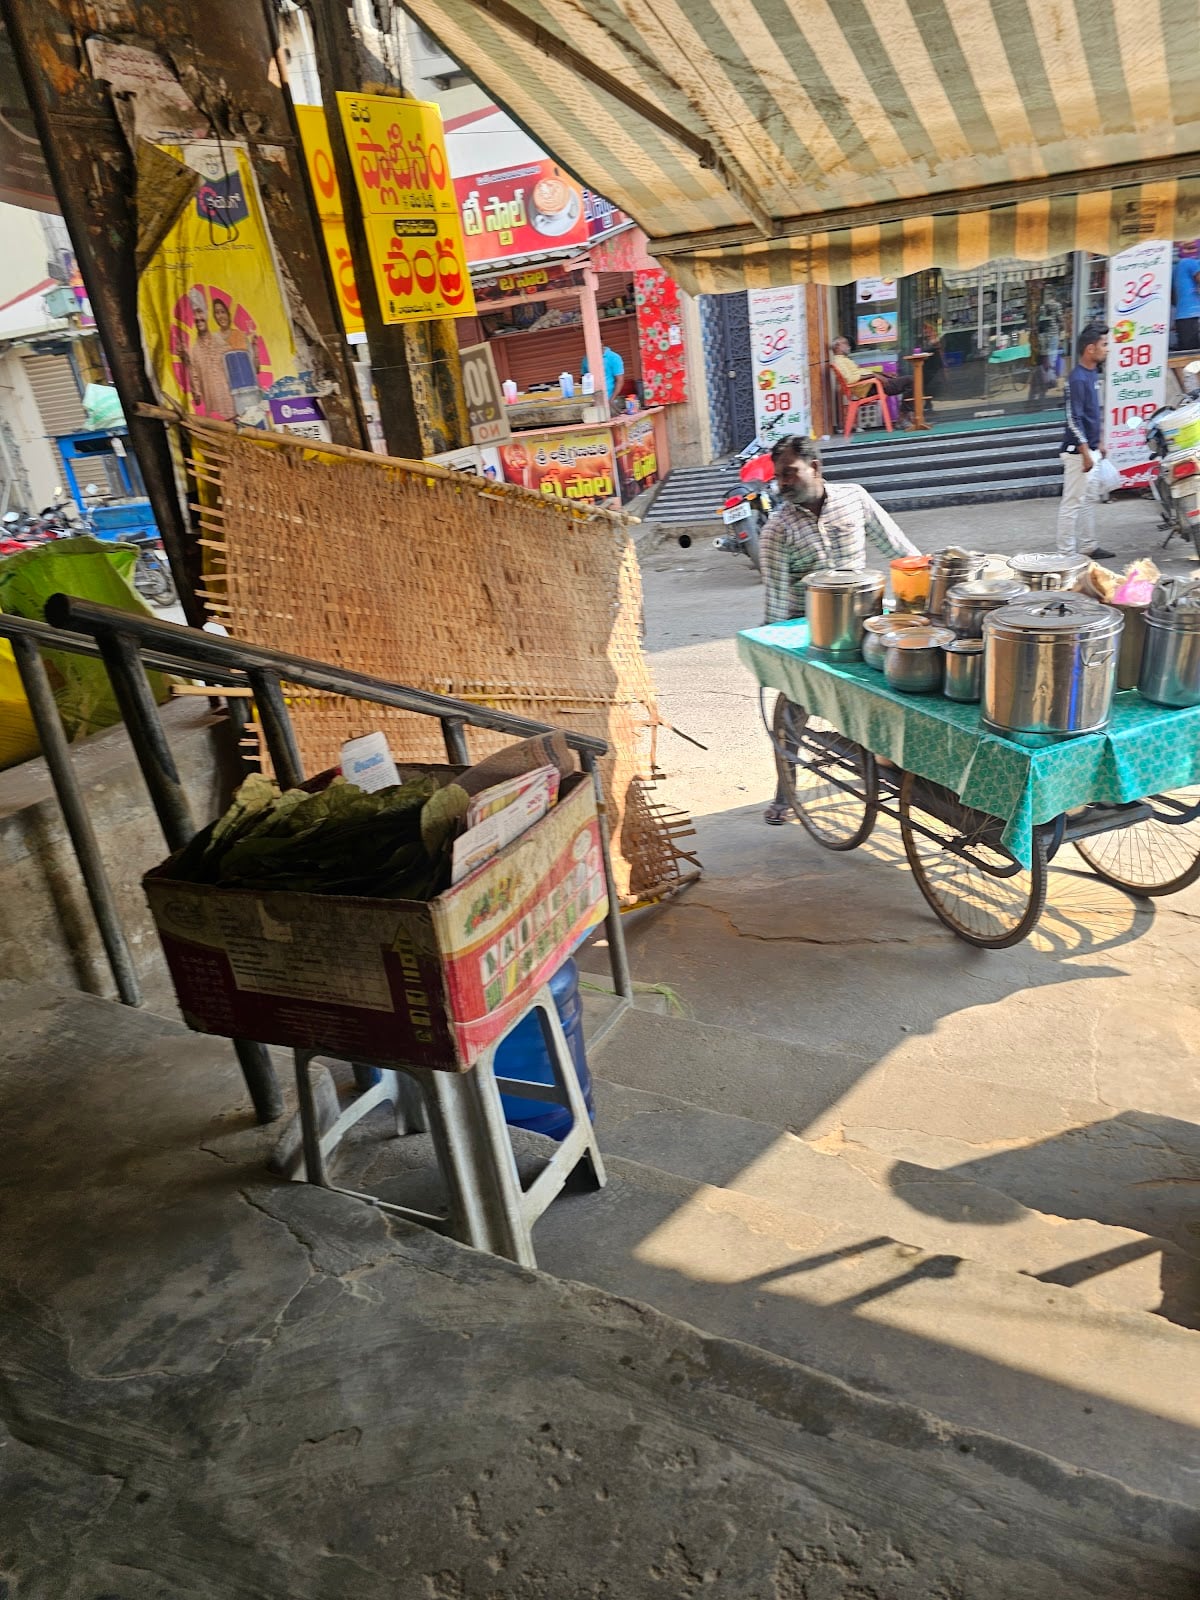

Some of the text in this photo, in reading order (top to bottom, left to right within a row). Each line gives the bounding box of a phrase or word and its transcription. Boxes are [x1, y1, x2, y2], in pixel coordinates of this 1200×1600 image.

[462, 190, 484, 236] టీ
[1119, 344, 1152, 368] 38
[764, 392, 792, 413] 38
